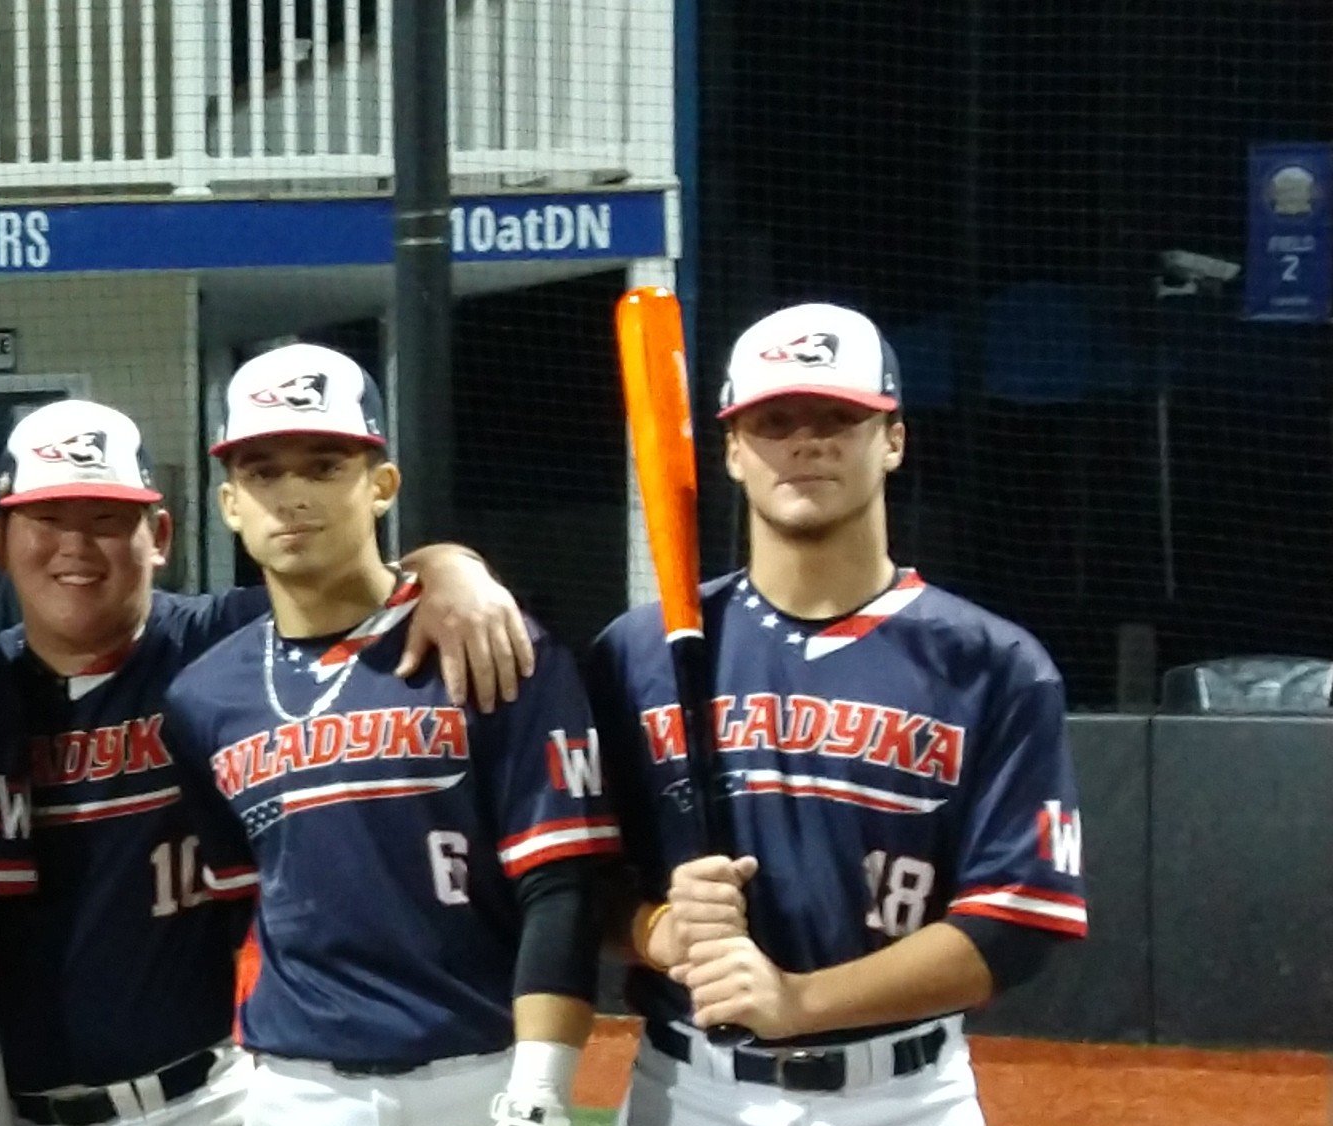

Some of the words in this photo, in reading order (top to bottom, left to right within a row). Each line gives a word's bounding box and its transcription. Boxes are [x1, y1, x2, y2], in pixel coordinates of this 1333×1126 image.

[449, 204, 612, 252] 10atDN
[209, 705, 471, 800] WLADYKA
[641, 692, 966, 786] WLADYKA
[426, 830, 471, 906] 6
